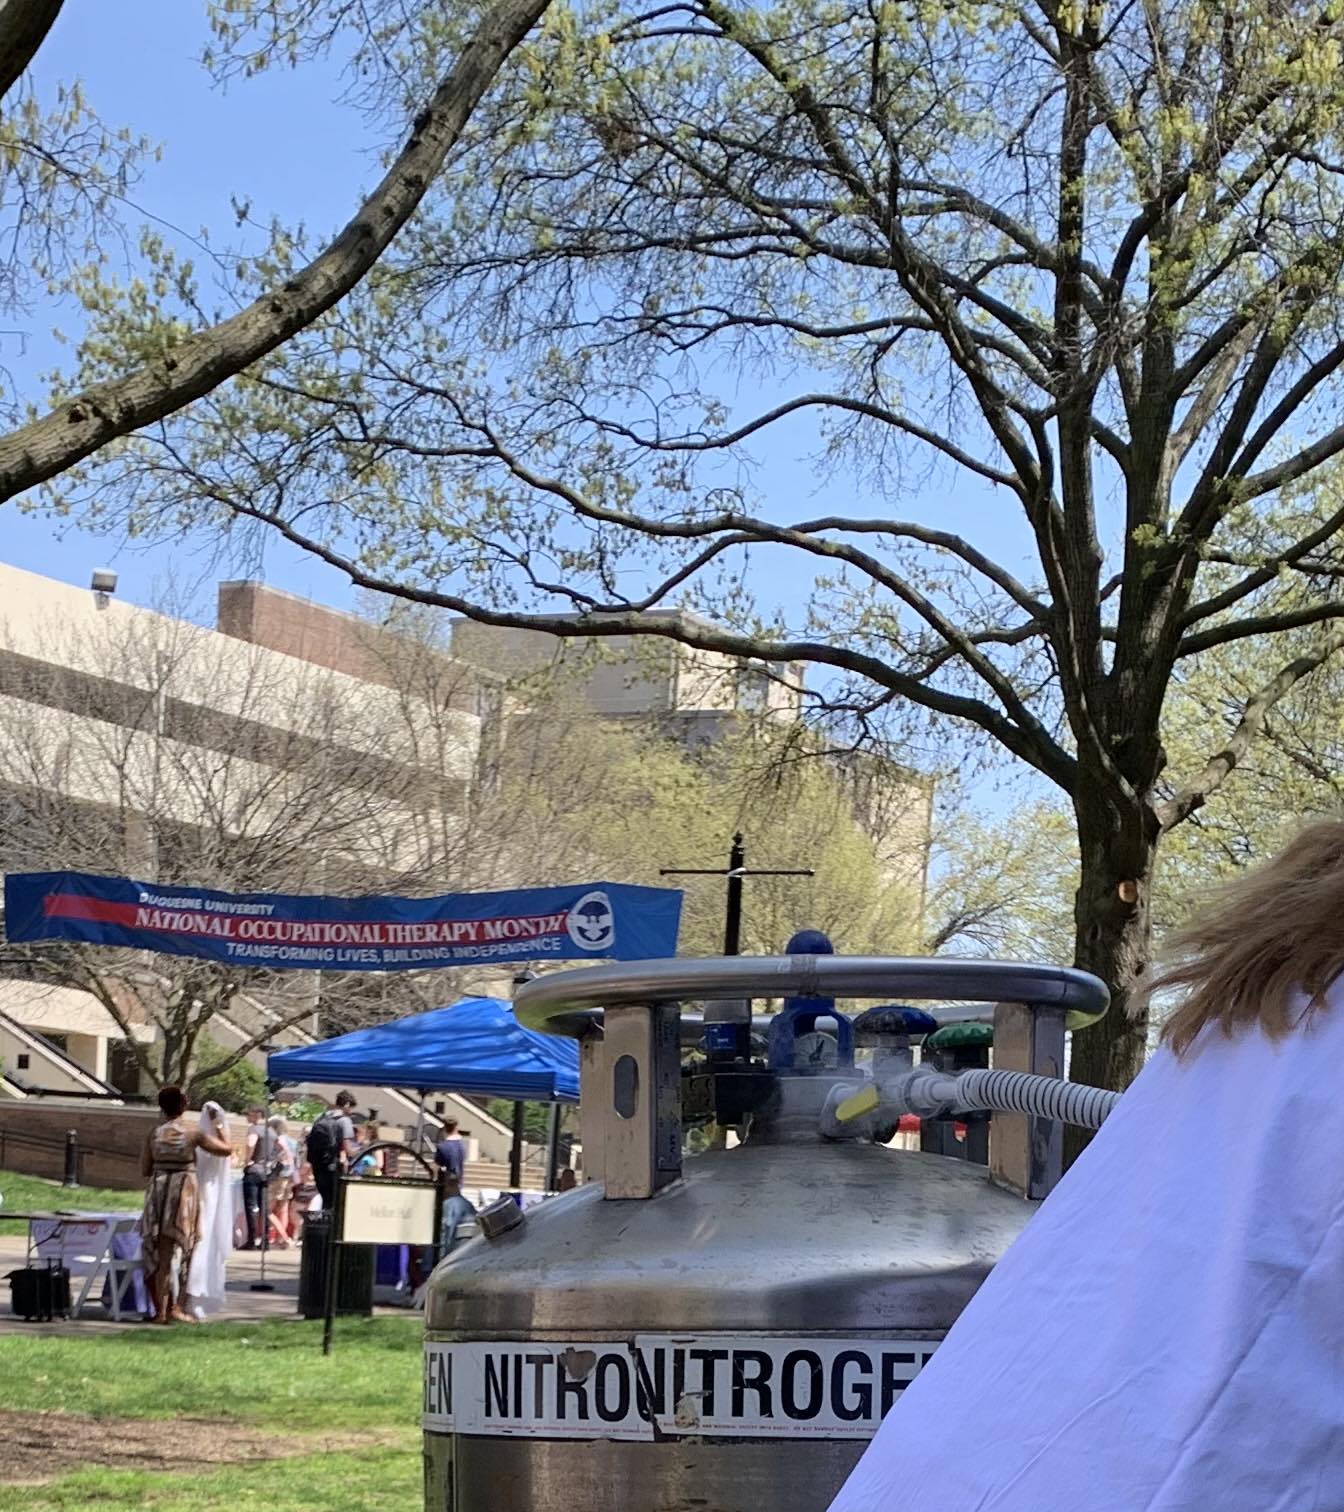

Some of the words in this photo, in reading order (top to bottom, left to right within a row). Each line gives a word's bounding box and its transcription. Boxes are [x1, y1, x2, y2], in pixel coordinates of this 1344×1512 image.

[204, 900, 275, 916] UNIVERSITY
[135, 908, 236, 937] NATIONAL
[238, 919, 386, 943] OCCUPATIONAL
[386, 921, 481, 943] THERAPY
[482, 914, 565, 940] MONTH
[225, 942, 334, 962] TRANSFORMING
[336, 948, 381, 964] LIVES,
[383, 947, 452, 962] BUILDING
[453, 937, 561, 958] INDEPENDENCE
[635, 1347, 935, 1421] NITROGE
